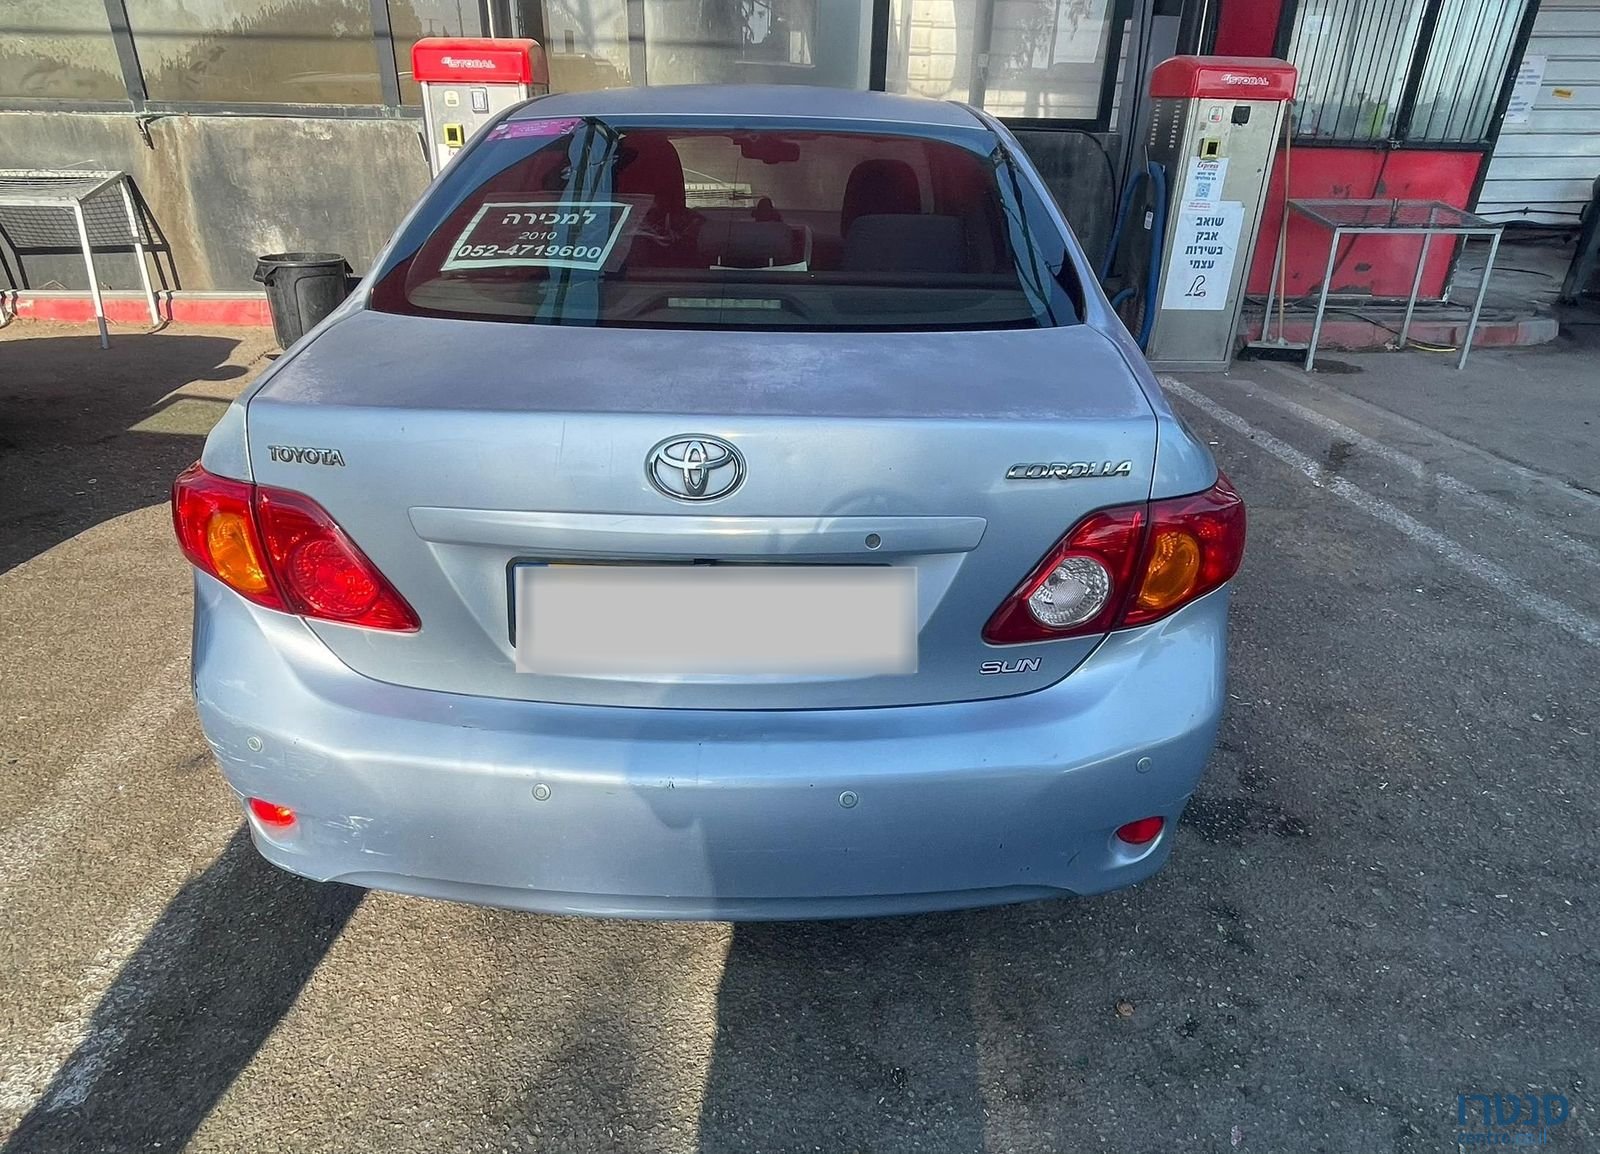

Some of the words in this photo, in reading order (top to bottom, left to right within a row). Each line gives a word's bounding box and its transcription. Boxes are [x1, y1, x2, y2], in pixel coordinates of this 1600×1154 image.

[501, 209, 597, 225] למכירה
[1195, 217, 1225, 227] שואב
[518, 231, 558, 241] 2010
[1195, 231, 1219, 243] אבק
[457, 244, 602, 259] 052-4719600
[1185, 245, 1223, 255] בשירות
[1189, 260, 1215, 269] עצמי
[268, 445, 345, 467] TOYOTA
[1006, 459, 1132, 480] COROLLA
[980, 657, 1042, 675] SUN
